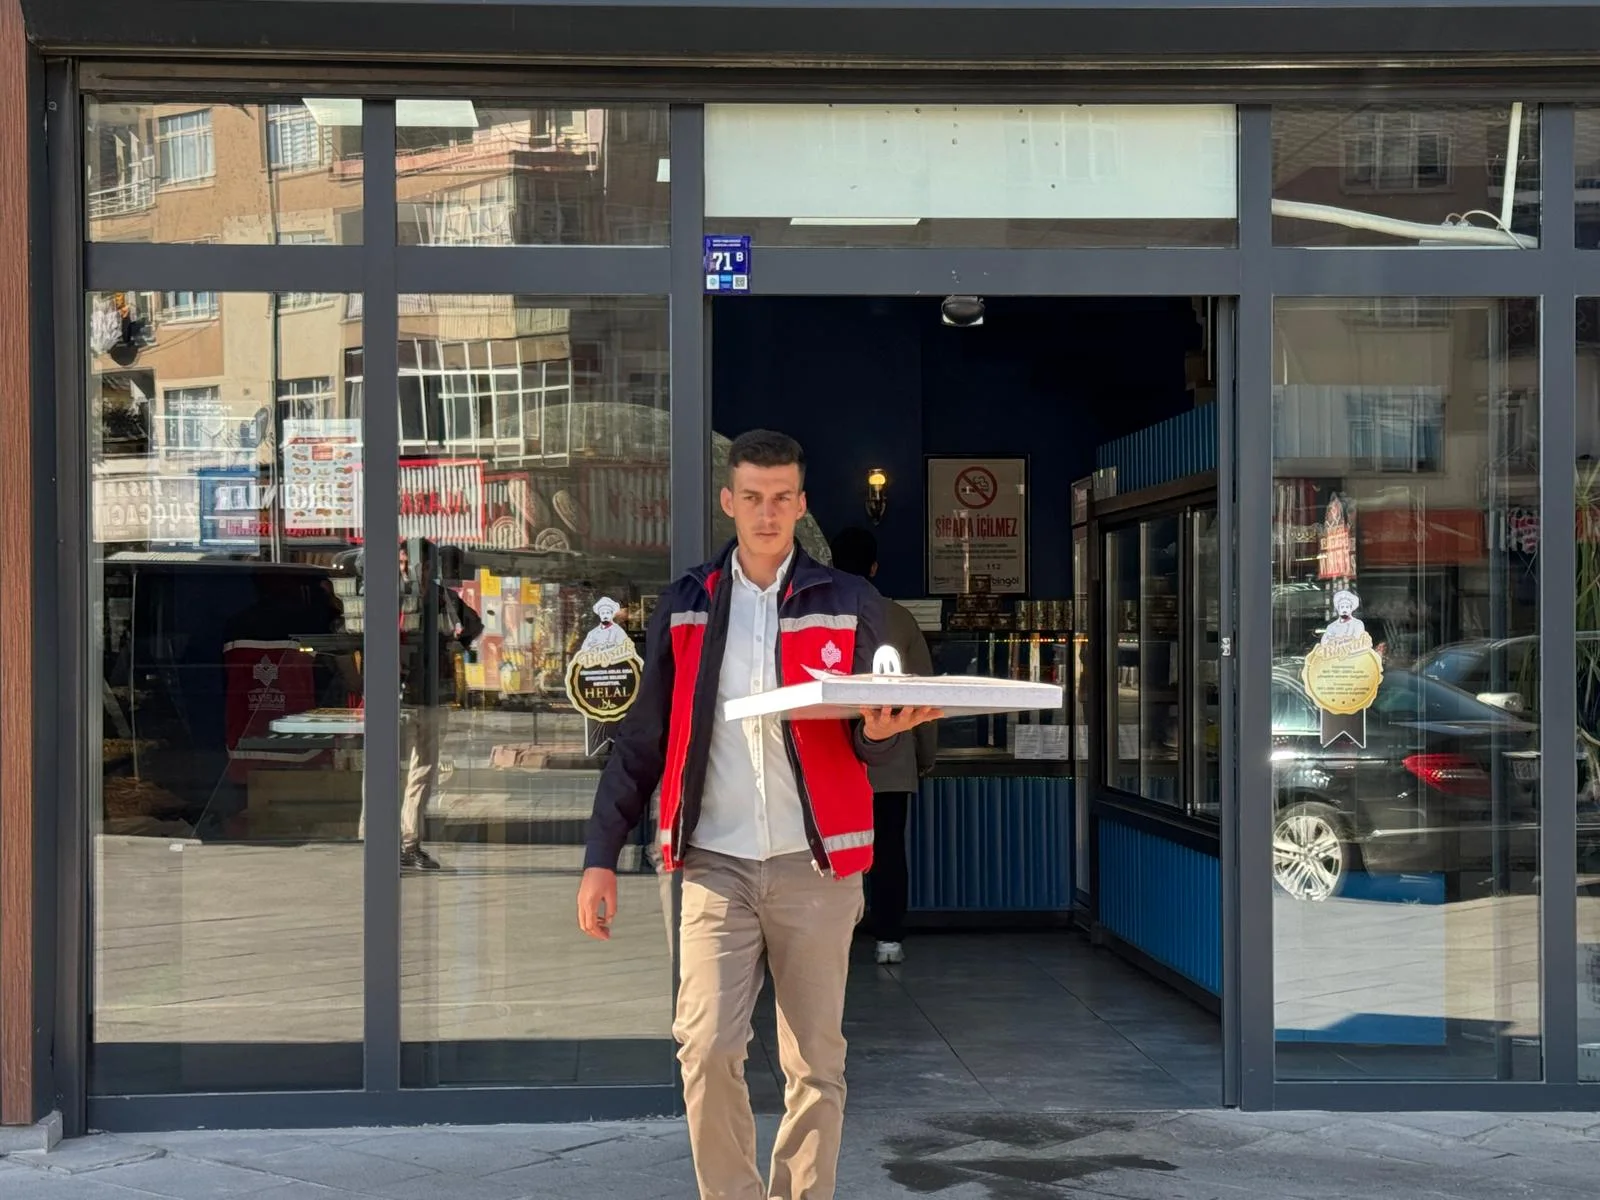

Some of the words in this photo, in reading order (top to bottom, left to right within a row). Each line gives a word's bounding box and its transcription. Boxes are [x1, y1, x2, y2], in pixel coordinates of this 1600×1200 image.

[712, 252, 733, 271] 71
[736, 251, 744, 262] B
[976, 513, 1018, 540] İÇİLMEZ
[584, 687, 630, 699] HELAL
